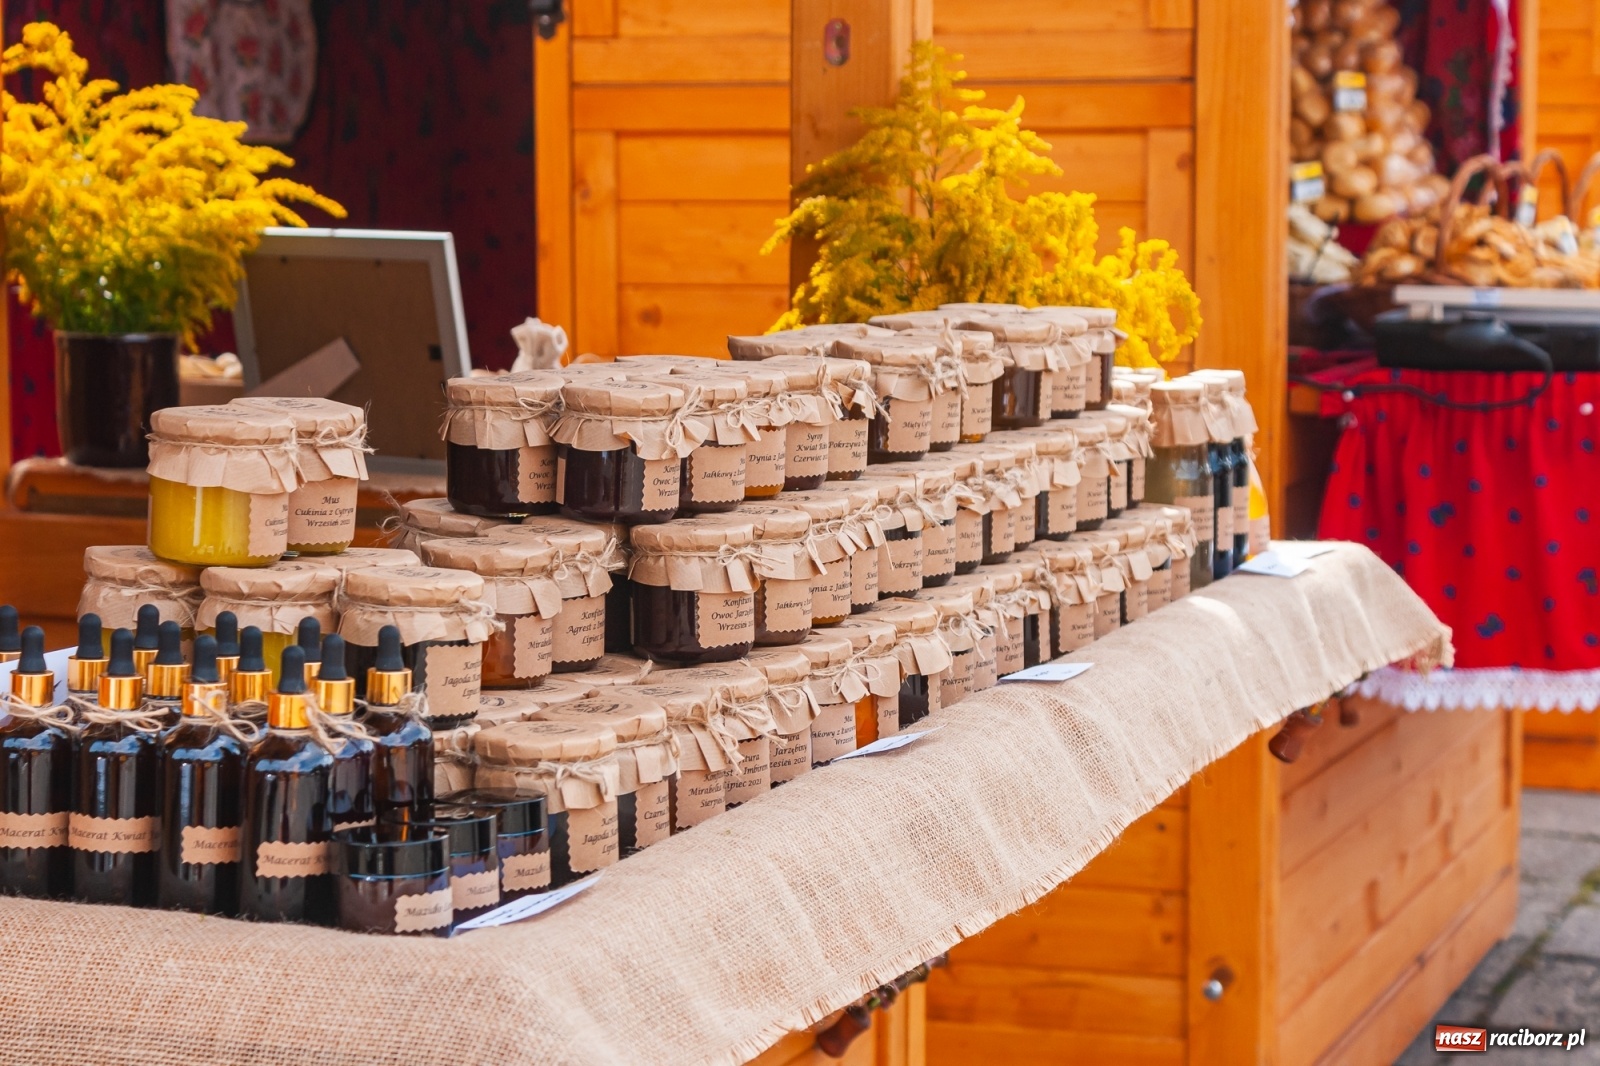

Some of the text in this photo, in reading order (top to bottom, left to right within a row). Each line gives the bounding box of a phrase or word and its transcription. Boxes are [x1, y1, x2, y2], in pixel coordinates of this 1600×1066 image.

[748, 454, 771, 464] Dynia
[529, 471, 550, 479] Owoc
[321, 496, 340, 505] Mus
[295, 508, 327, 516] Cukinia
[305, 519, 339, 527] Wrzesień
[809, 584, 827, 594] ynia
[711, 612, 733, 620] Owoc
[566, 623, 591, 635] Agrest
[774, 744, 807, 757] Jarzębiny
[0, 827, 45, 837] Macerat
[111, 831, 145, 841] Kwiat
[263, 855, 311, 865] Macerat
